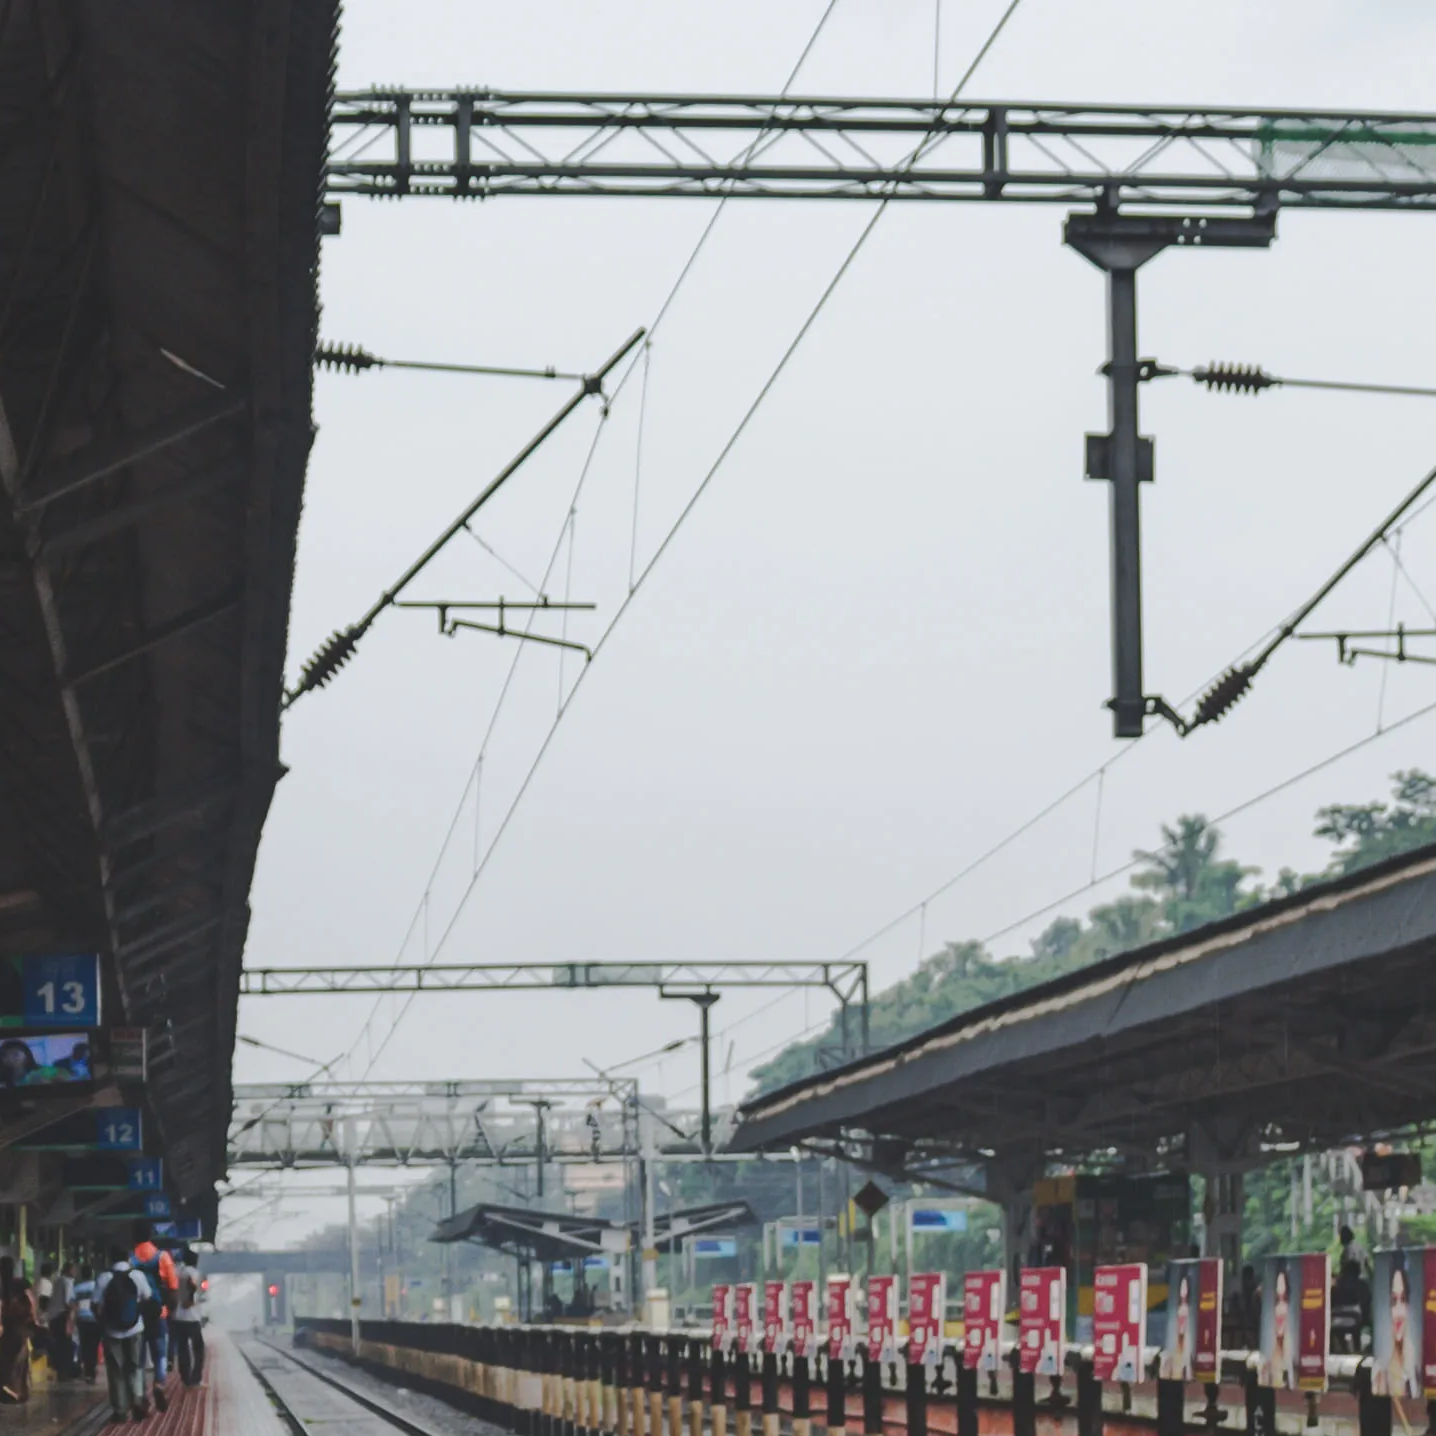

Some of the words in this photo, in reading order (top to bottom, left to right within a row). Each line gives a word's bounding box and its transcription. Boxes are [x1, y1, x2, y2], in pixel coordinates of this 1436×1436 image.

[35, 980, 87, 1014] 13
[104, 1123, 134, 1143] 12
[133, 1168, 156, 1186] 11
